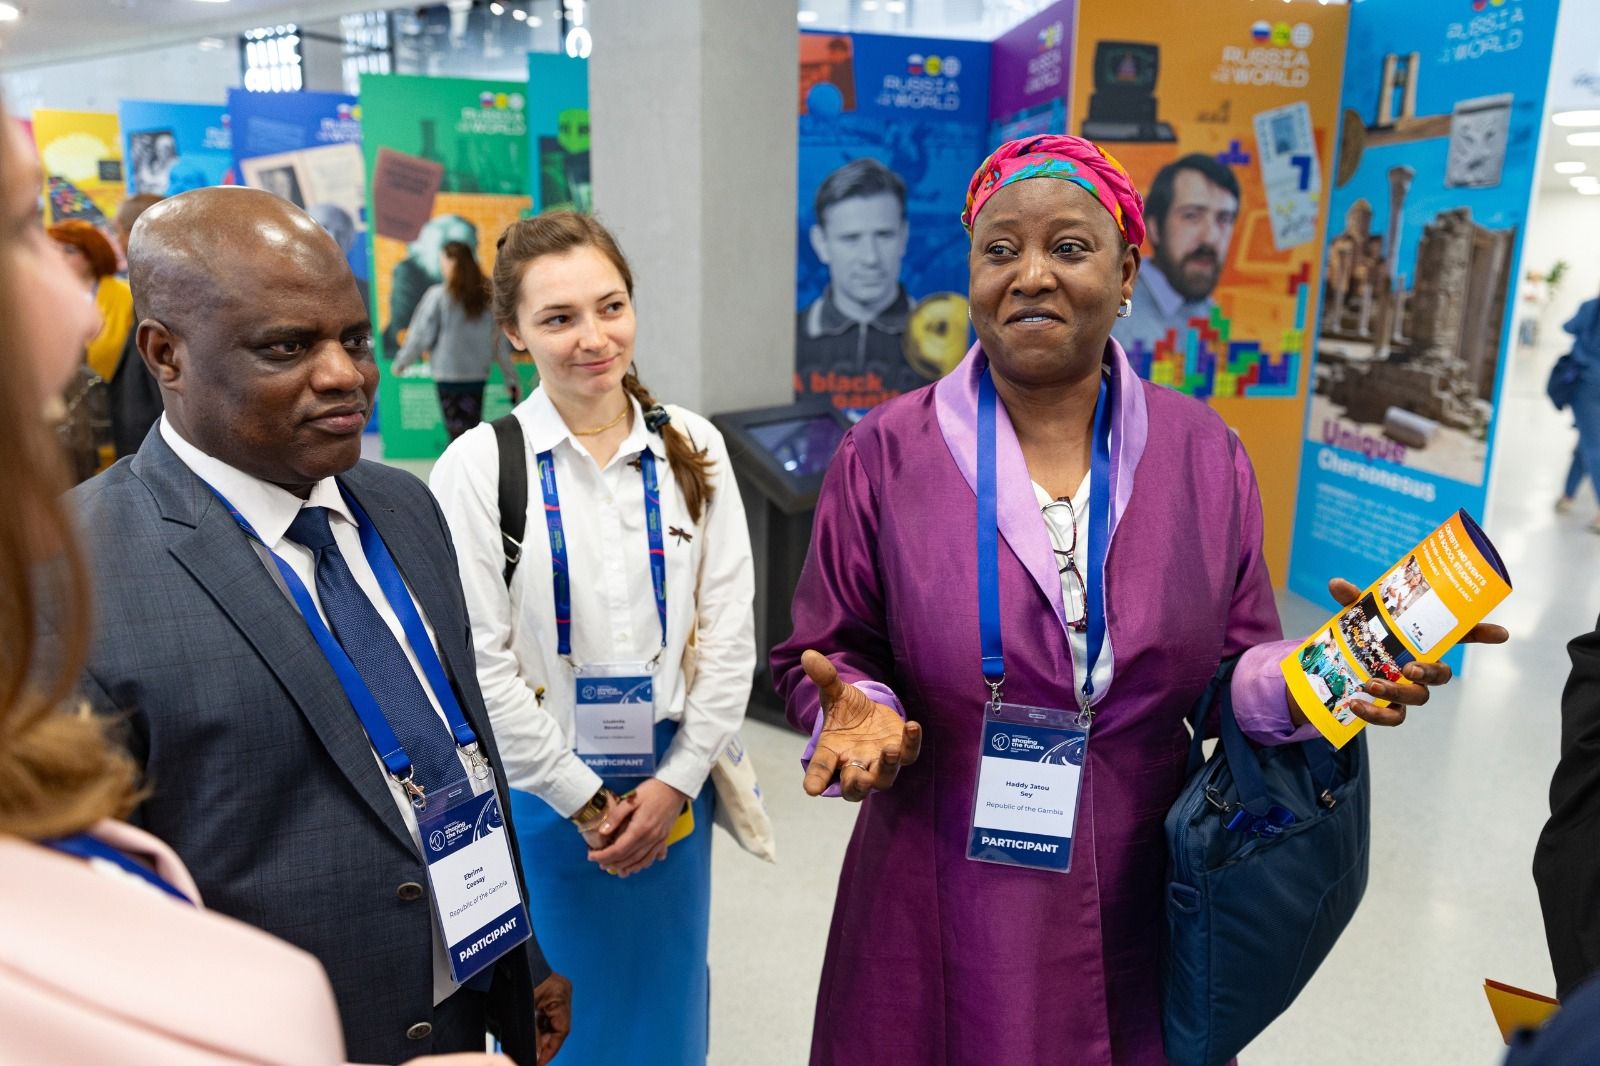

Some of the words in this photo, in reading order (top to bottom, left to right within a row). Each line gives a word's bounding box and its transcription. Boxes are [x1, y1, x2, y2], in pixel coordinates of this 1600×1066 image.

[1446, 7, 1524, 40] RUSSIA
[1454, 28, 1523, 60] WORLD
[1223, 46, 1310, 68] RUSSIA
[884, 75, 959, 96] RUSSIA
[1233, 65, 1309, 88] WORLD
[895, 93, 960, 111] WORLD
[810, 369, 883, 393] black
[1322, 419, 1407, 465] Unique
[1453, 561, 1481, 594] STUDENTS
[1465, 560, 1487, 586] EVENTS
[586, 758, 644, 767] PARTICIPANT
[1006, 781, 1029, 790] Haddy
[1030, 783, 1050, 791] Jatou
[986, 801, 1016, 811] Republic
[1037, 807, 1064, 816] Gambia
[445, 821, 466, 834] shaping
[456, 823, 472, 835] future
[981, 836, 1059, 854] PARTICIPANT
[463, 866, 484, 881] Ebrima
[466, 875, 486, 890] Ceesay
[449, 900, 474, 918] Republic
[473, 896, 479, 904] of
[478, 892, 489, 901] the
[488, 879, 508, 895] Gambia
[459, 917, 517, 963] PARTICIPANT
